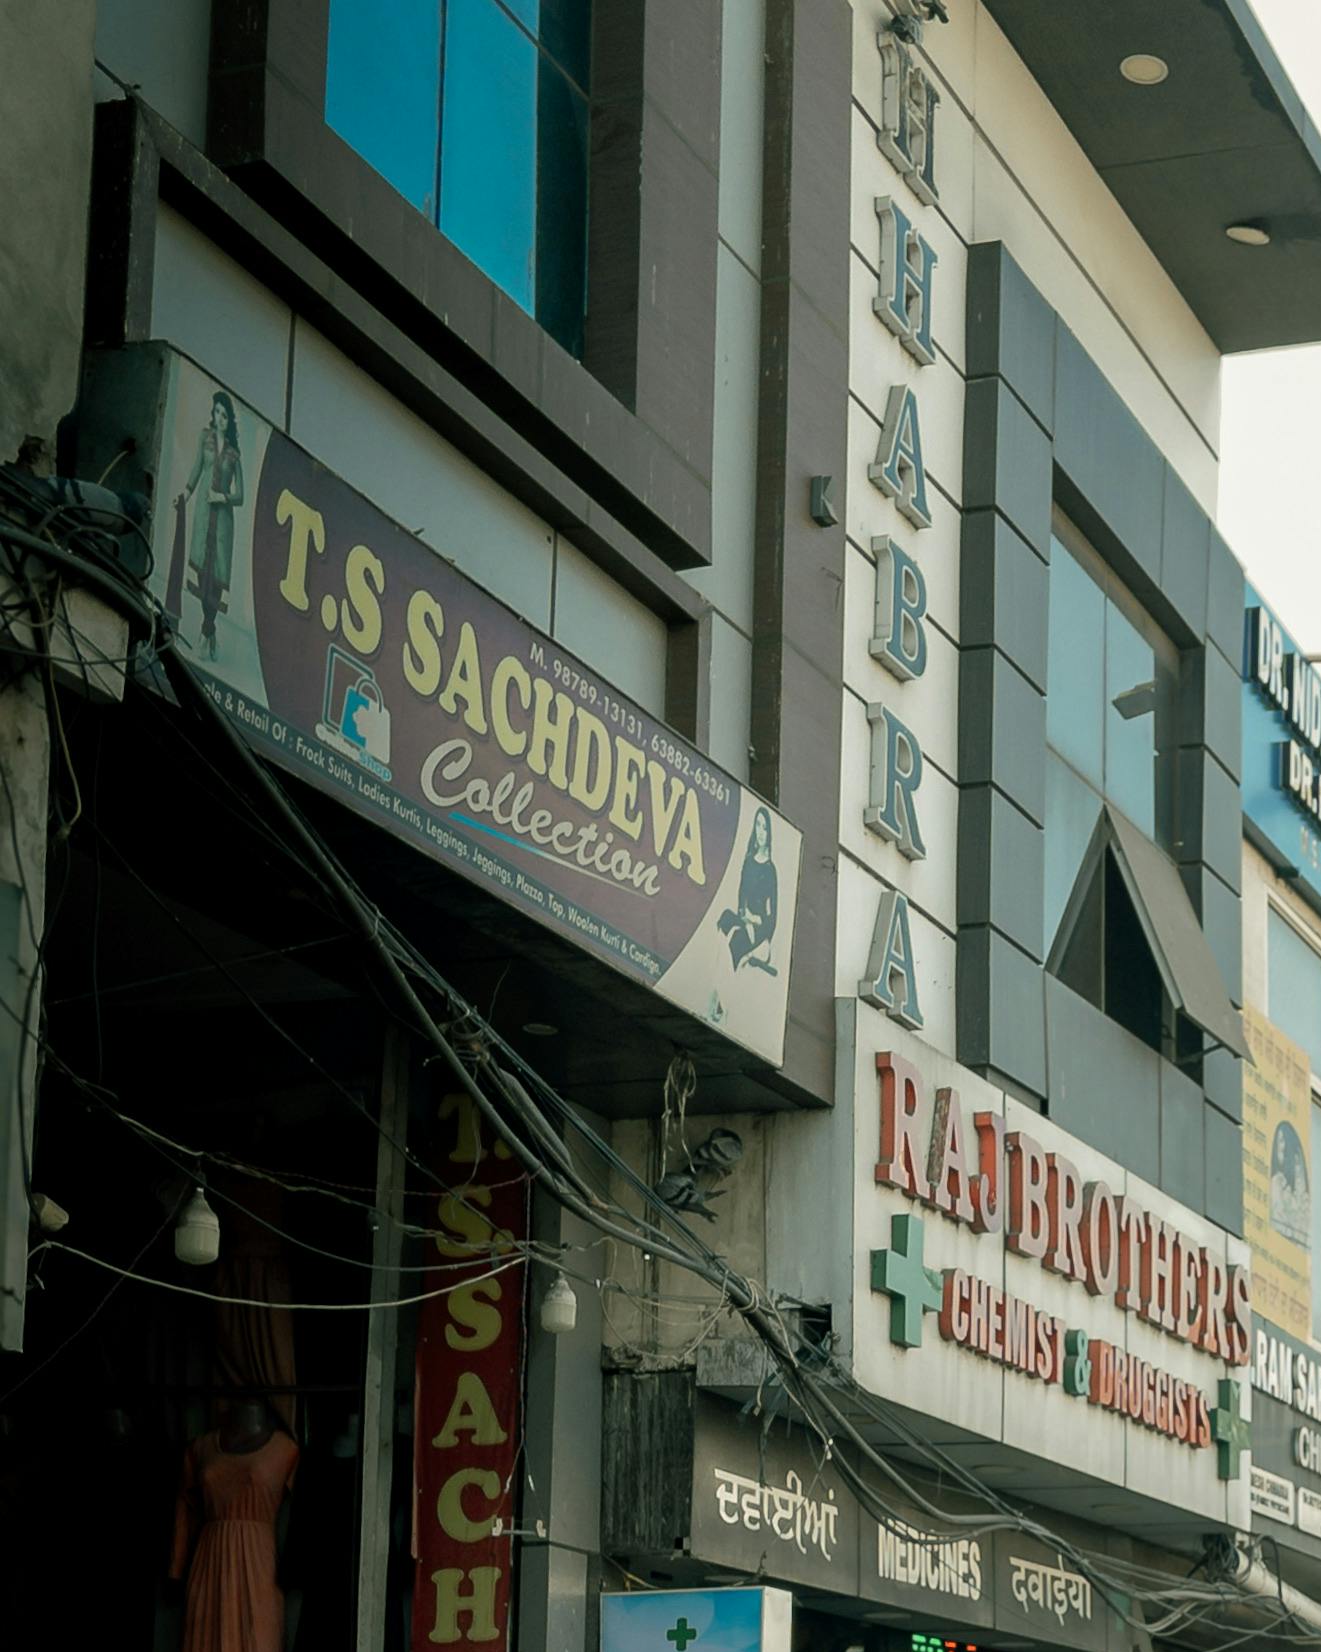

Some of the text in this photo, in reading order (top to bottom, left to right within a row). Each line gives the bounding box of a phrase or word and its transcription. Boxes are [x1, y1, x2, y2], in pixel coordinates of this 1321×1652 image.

[403, 589, 706, 885] SACHDEVA
[530, 643, 730, 805] M. 98789-13131, 63882-63361
[1257, 606, 1289, 711] DR.
[225, 692, 234, 711] &
[237, 700, 270, 734] Retail
[272, 722, 288, 744] Of
[296, 737, 325, 771] Frock
[328, 756, 355, 789] Suits,
[358, 774, 390, 809] Ladies
[393, 799, 424, 832] Kurtis,
[426, 819, 470, 860] Leggings,
[472, 848, 515, 889] Jeggings,
[548, 893, 567, 918] Top,
[568, 906, 600, 937] Woolen
[601, 926, 620, 949] Kurti
[621, 940, 628, 953] &
[420, 738, 660, 896] Collection
[1289, 740, 1316, 810] DR.
[874, 1051, 1006, 1234] RAJ
[1003, 1131, 1252, 1367] BROTHERS
[939, 1267, 1212, 1450] CHEMIST & DRUGGISTS
[713, 1467, 838, 1562] ਦਵਾਈਆਂ
[877, 1516, 982, 1601] MEDICINES
